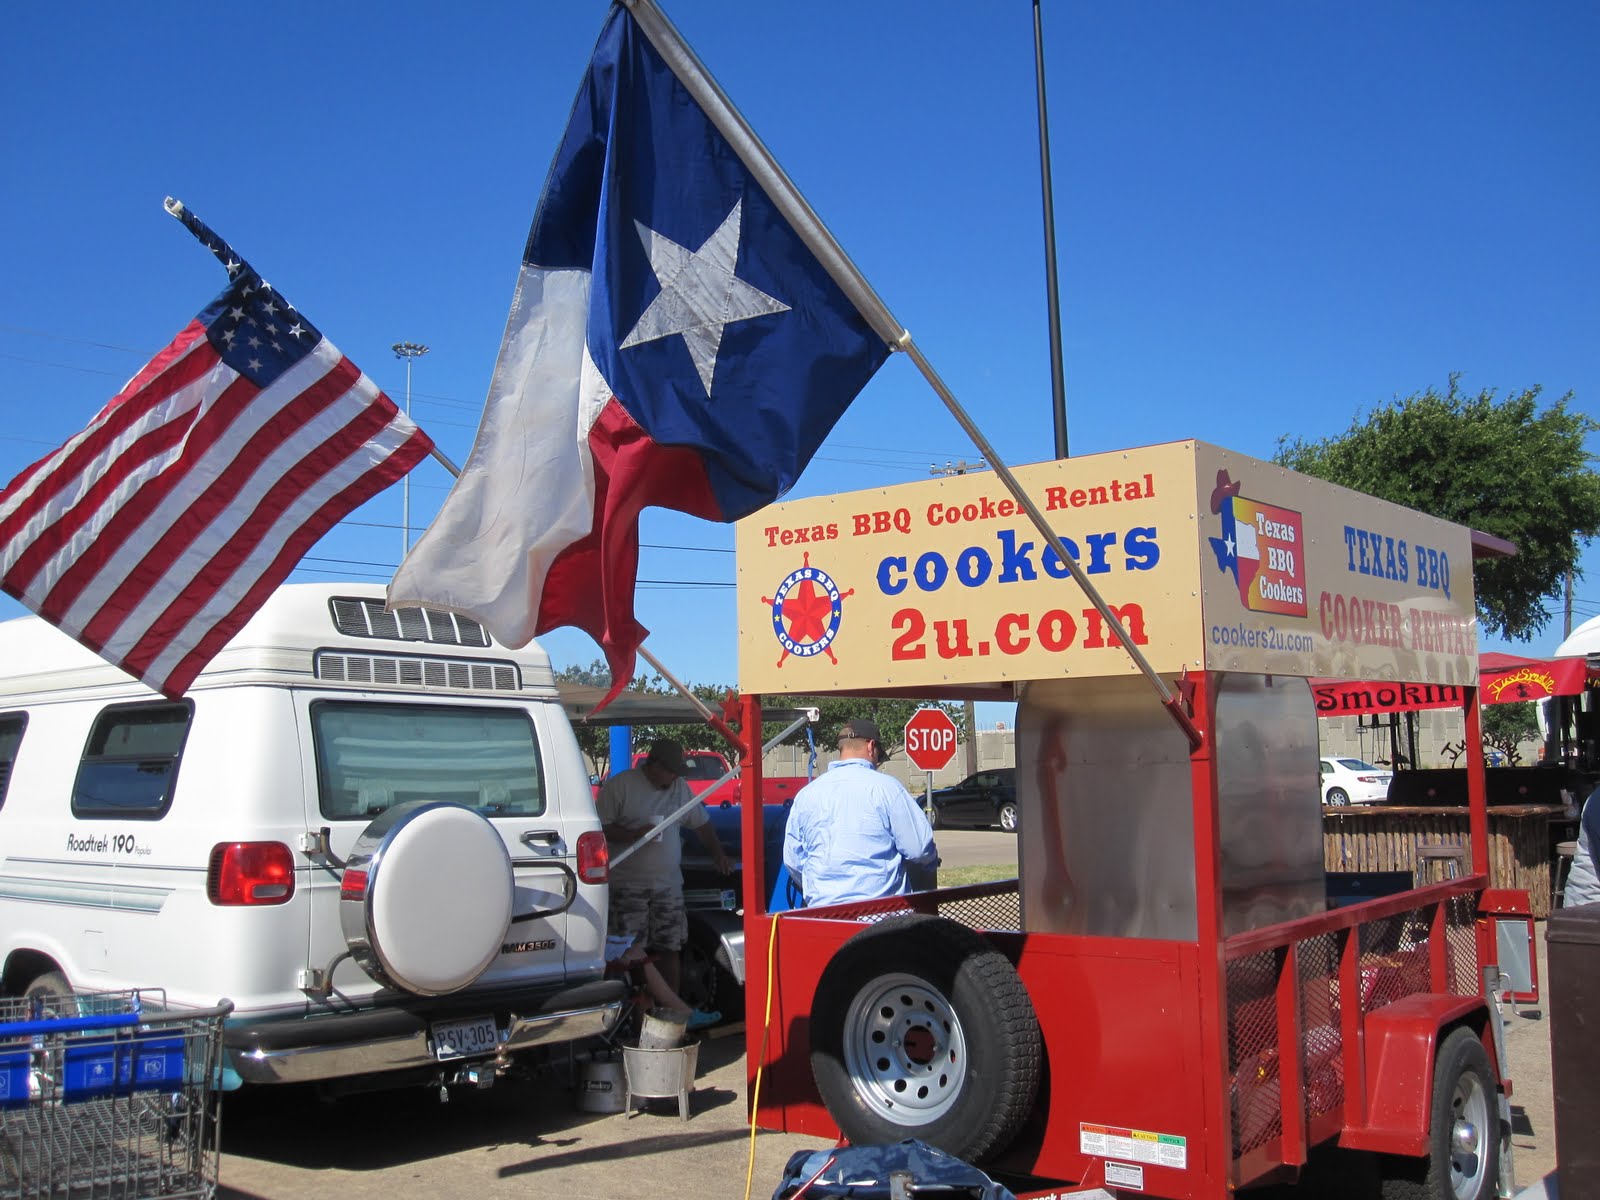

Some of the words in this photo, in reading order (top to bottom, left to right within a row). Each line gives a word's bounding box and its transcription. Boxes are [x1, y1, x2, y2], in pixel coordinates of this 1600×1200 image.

[765, 524, 839, 547] Texas
[852, 508, 911, 537] BBQ
[1045, 474, 1155, 511] Rental
[1256, 512, 1295, 542] Texas
[876, 527, 1160, 595] cookers
[1267, 546, 1295, 578] BBQ
[1344, 525, 1408, 583] TEXAS
[1415, 545, 1451, 600] BBQ
[775, 569, 812, 605] TEXAS
[816, 572, 839, 602] BBQ
[1260, 575, 1303, 604] Cookers
[891, 603, 1149, 661] 2u.com
[1212, 623, 1314, 652] cookers2u.com
[1320, 591, 1403, 649] COOKER
[1409, 608, 1475, 656] RENTAL
[779, 629, 834, 655] COOKERS
[1316, 682, 1459, 711] Smokin
[909, 728, 953, 751] STOP
[67, 833, 108, 853] Roadtrek
[112, 834, 135, 854] 190
